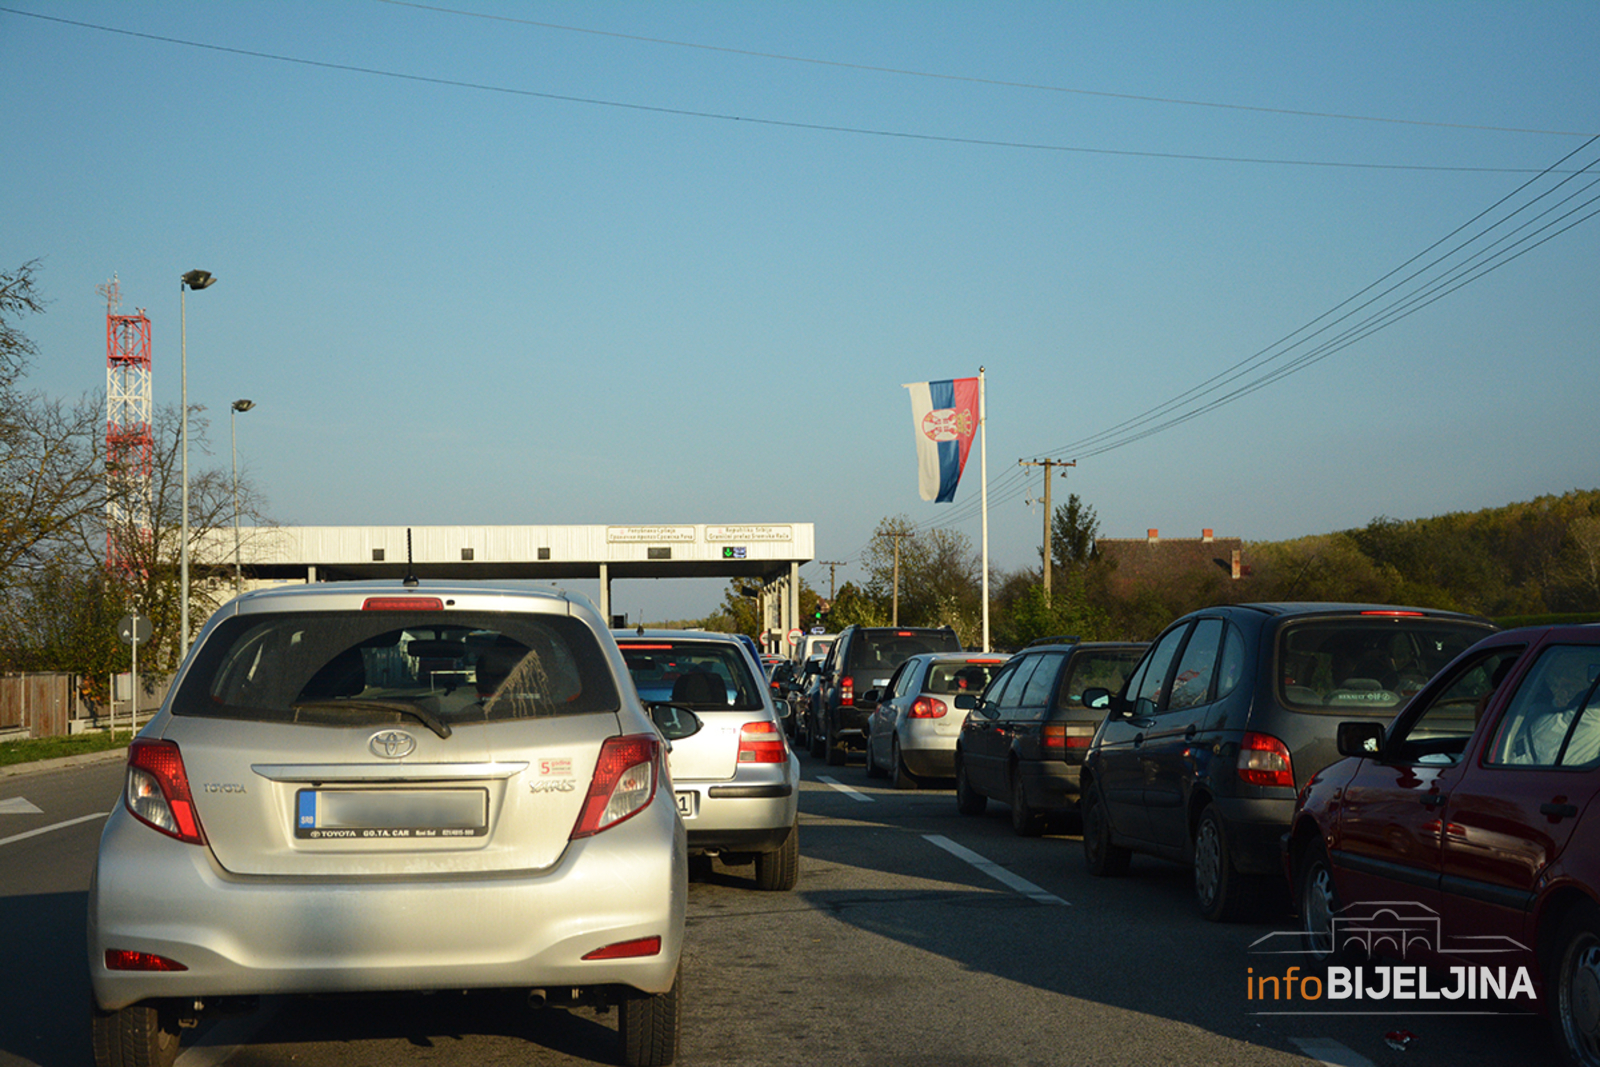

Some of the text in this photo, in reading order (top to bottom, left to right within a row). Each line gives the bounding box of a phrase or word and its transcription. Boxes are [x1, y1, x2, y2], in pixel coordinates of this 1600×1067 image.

[541, 761, 550, 775] 5
[204, 783, 248, 794] TOYOTA
[529, 779, 577, 794] YARIS
[300, 815, 314, 825] SRB
